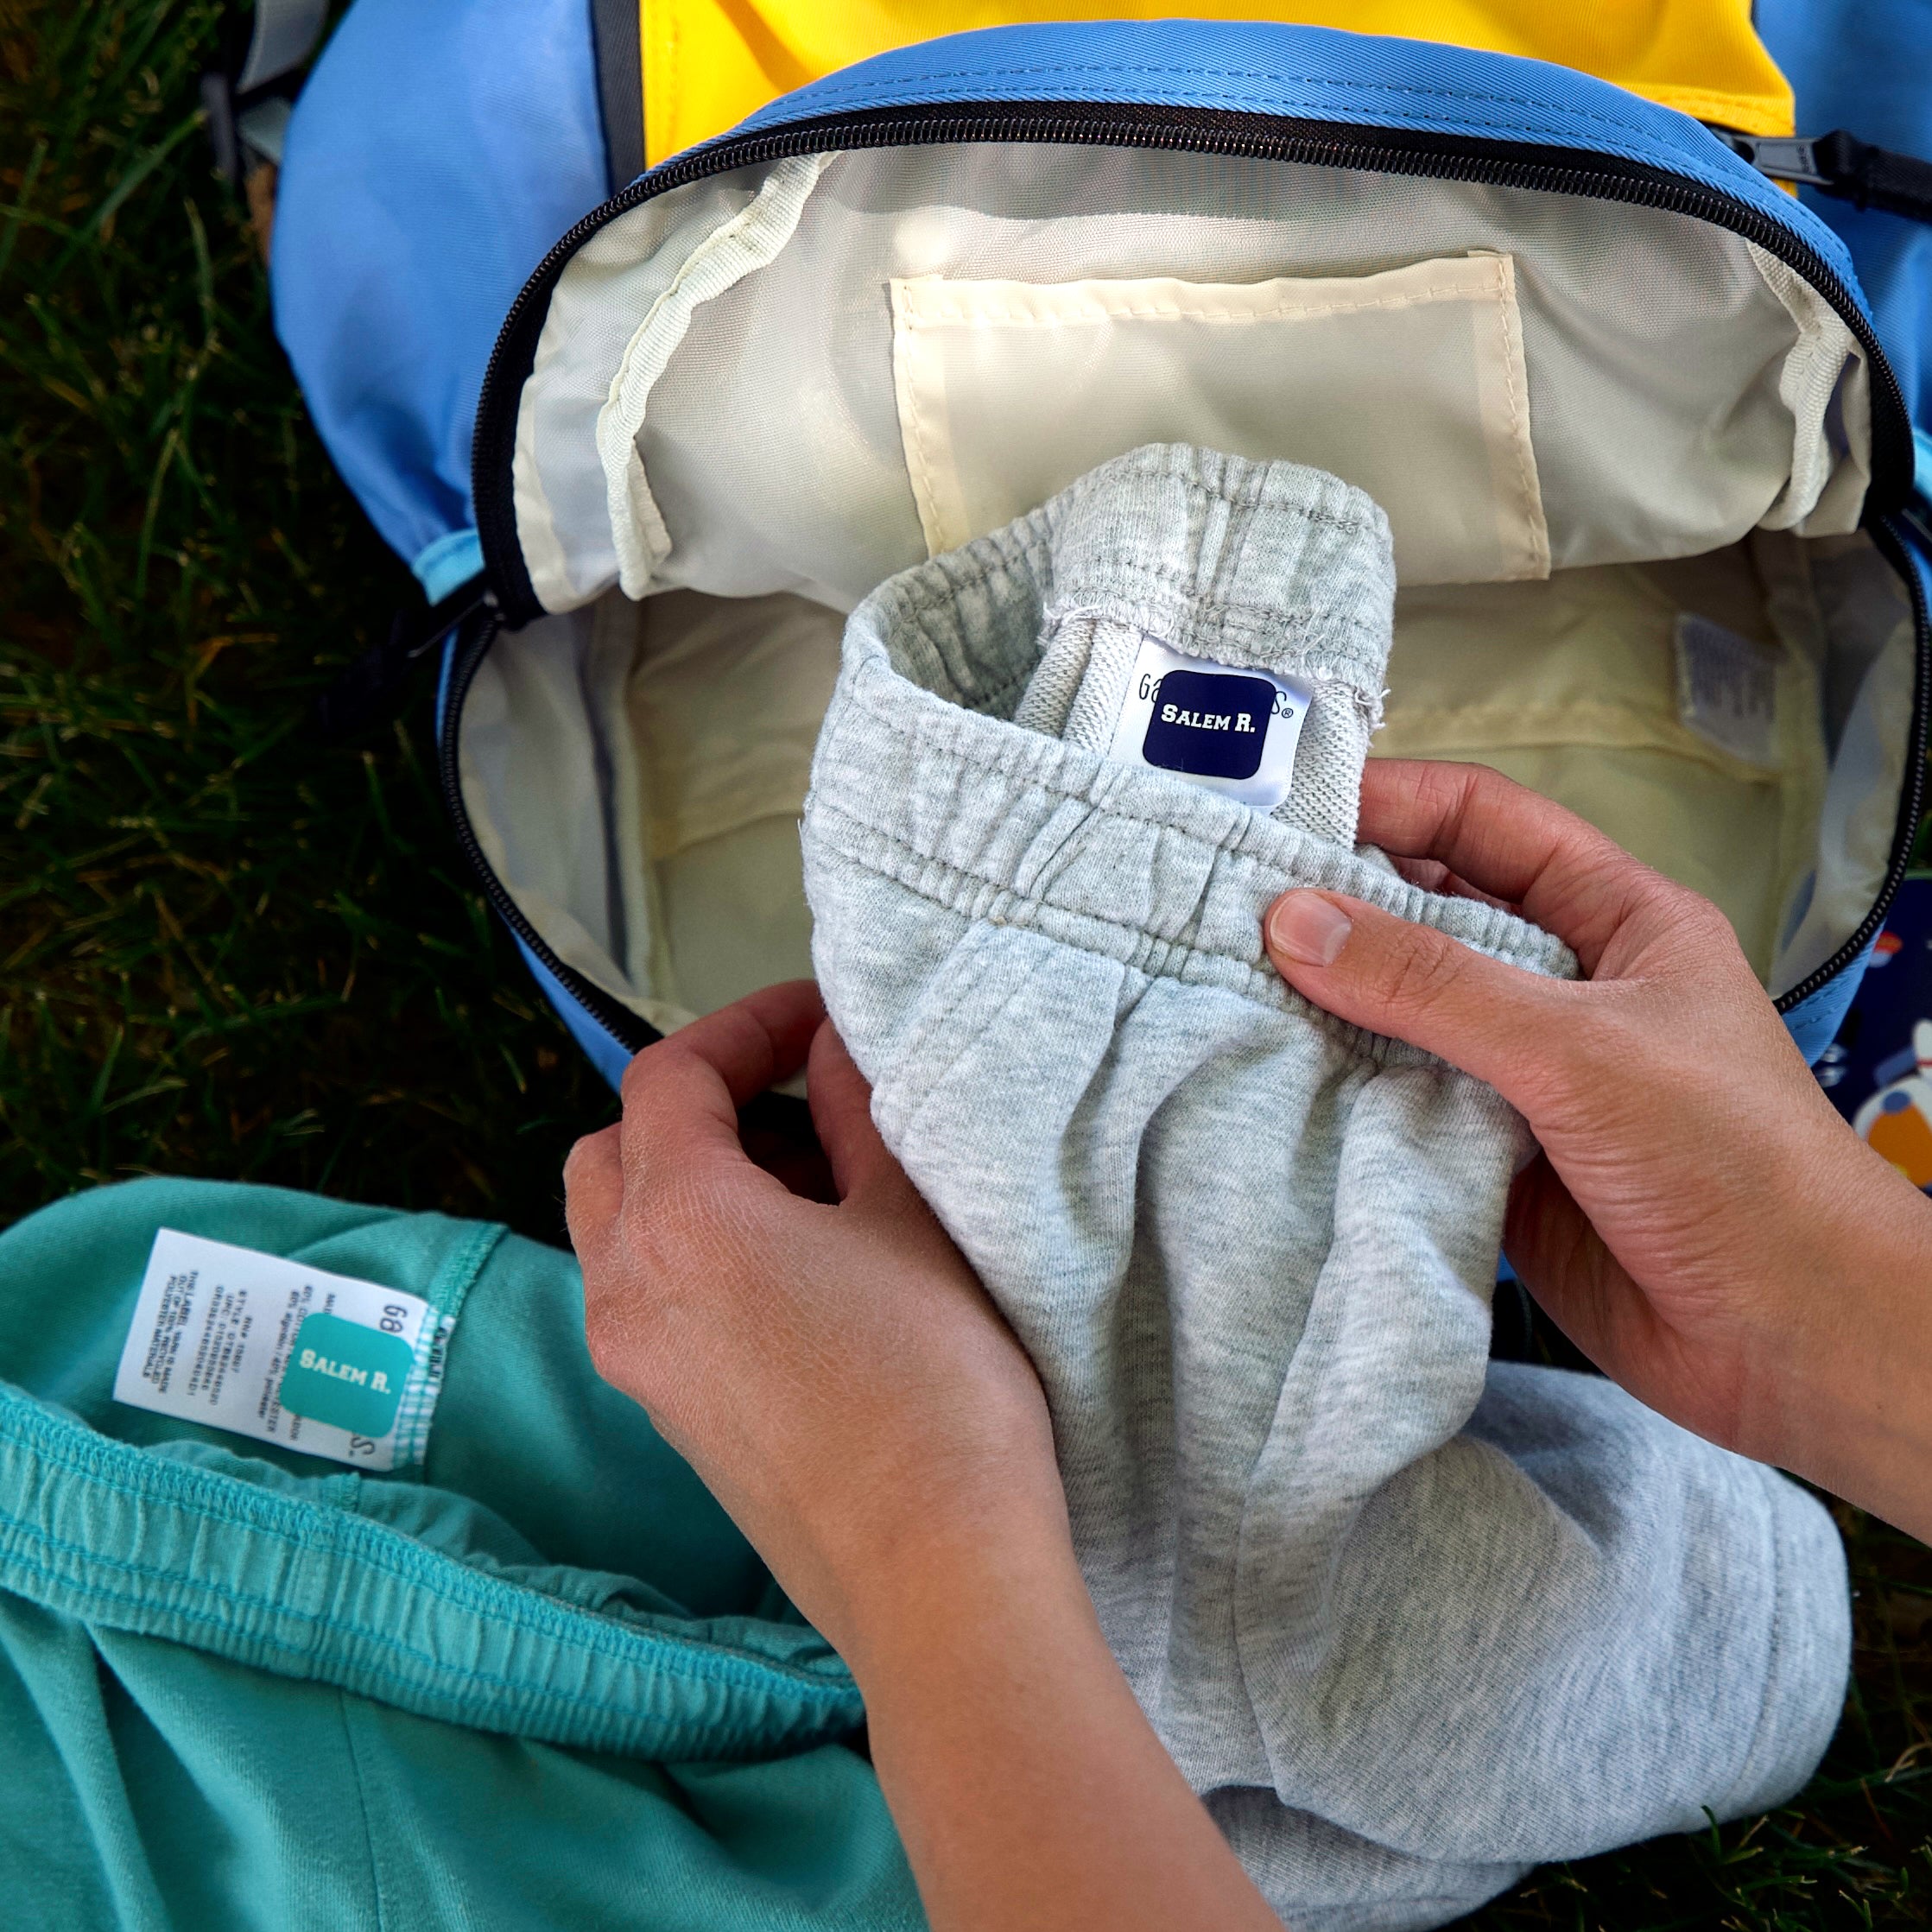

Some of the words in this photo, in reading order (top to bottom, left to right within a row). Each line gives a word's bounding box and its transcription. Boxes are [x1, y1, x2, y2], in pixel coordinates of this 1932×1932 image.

[1161, 703, 1231, 731] SALEM
[1235, 713, 1256, 732] R.
[177, 1292, 193, 1326] LABEL
[299, 1348, 368, 1386] SALEM
[371, 1370, 391, 1394] R.
